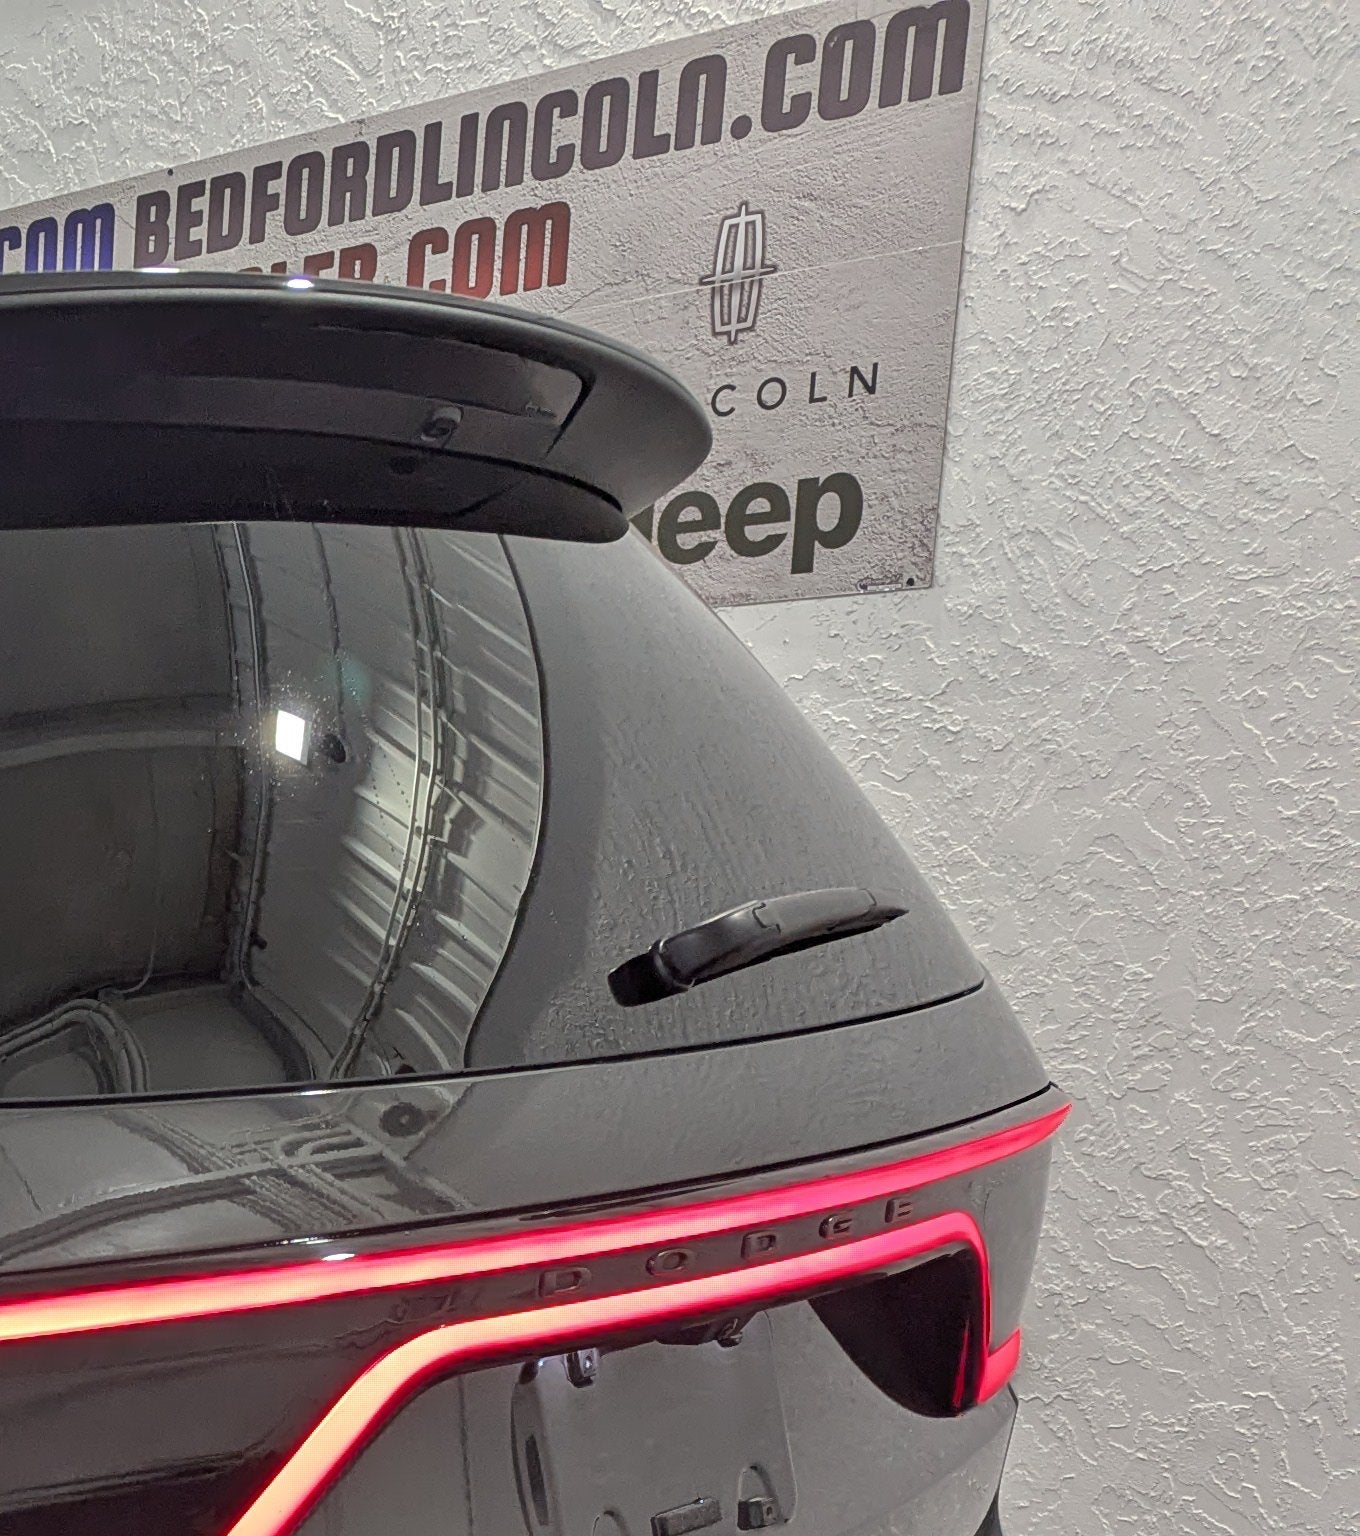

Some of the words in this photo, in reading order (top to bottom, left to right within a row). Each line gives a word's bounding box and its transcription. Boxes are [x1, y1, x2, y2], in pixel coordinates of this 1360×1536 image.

[133, 0, 970, 269] BEDFORDLINCOLN.COM
[630, 472, 863, 575] eep
[539, 1198, 914, 1298] DODGE
